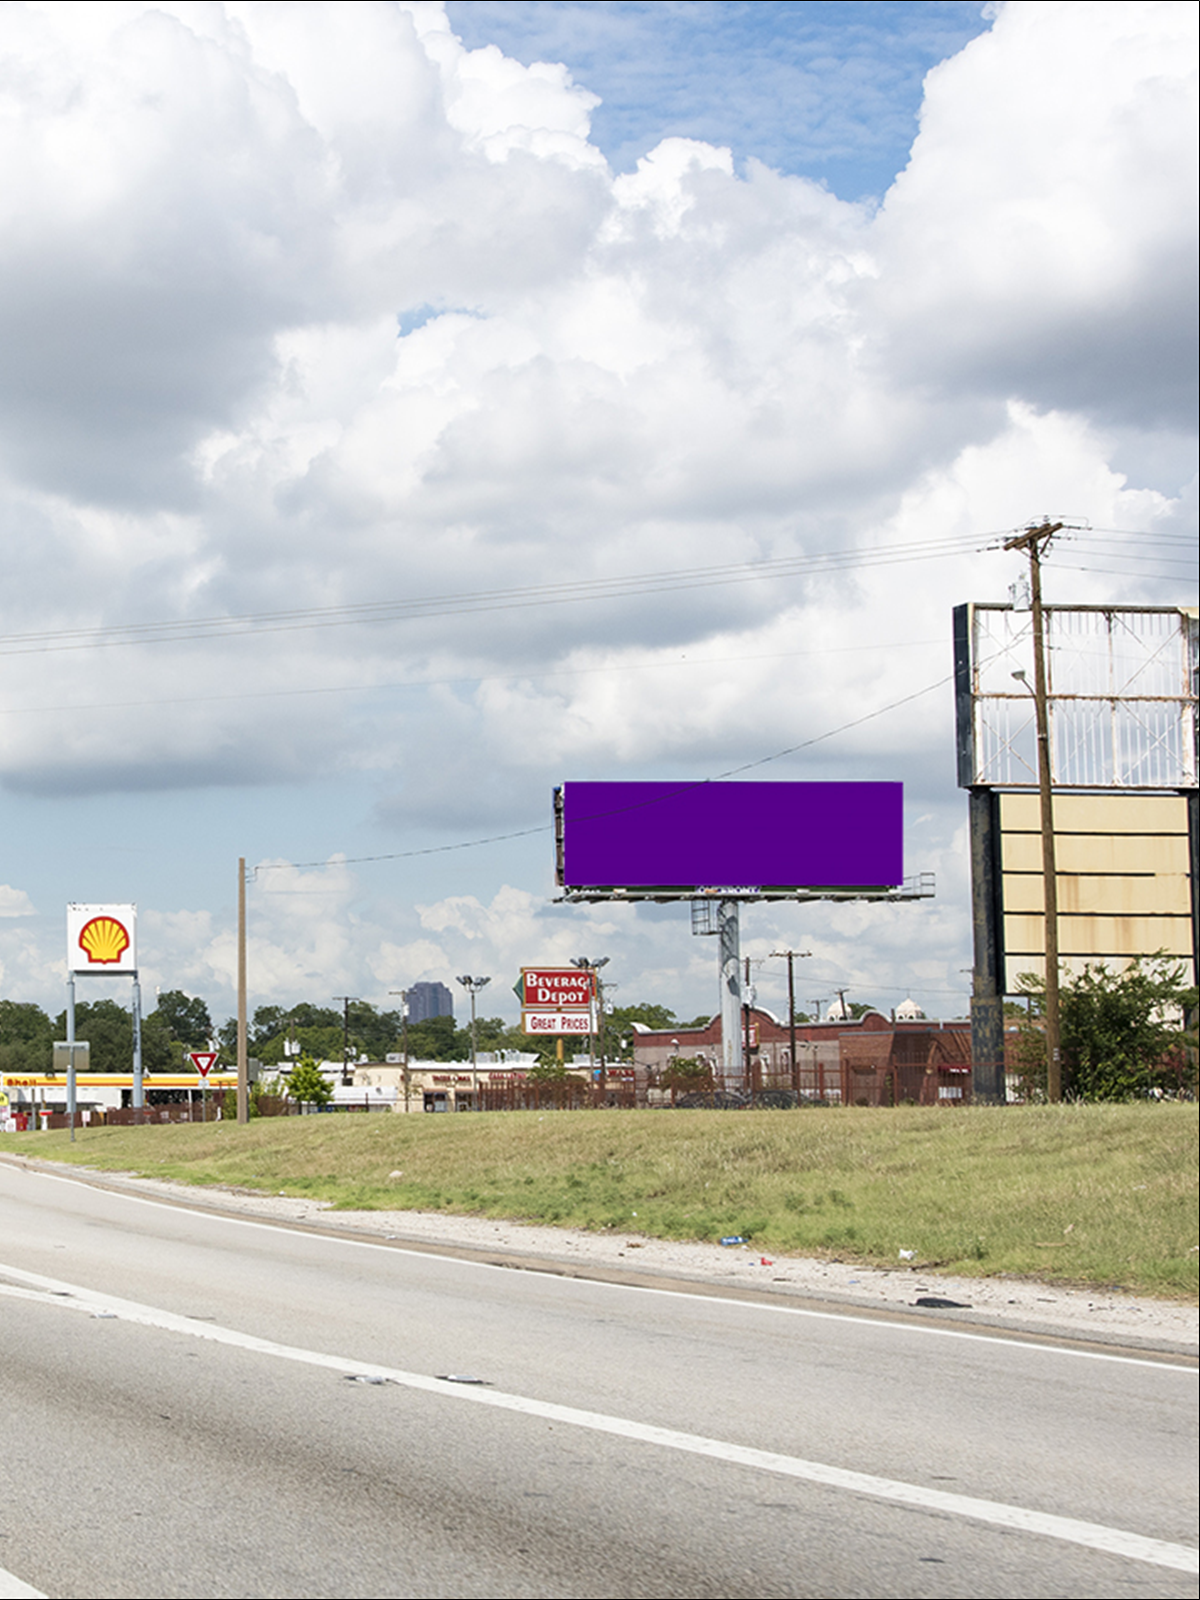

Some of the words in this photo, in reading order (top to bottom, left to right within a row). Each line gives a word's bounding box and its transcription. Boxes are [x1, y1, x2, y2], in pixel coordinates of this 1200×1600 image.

[537, 988, 585, 1005] DEPOT
[531, 1016, 556, 1030] GREAT
[561, 1016, 588, 1030] PRICES
